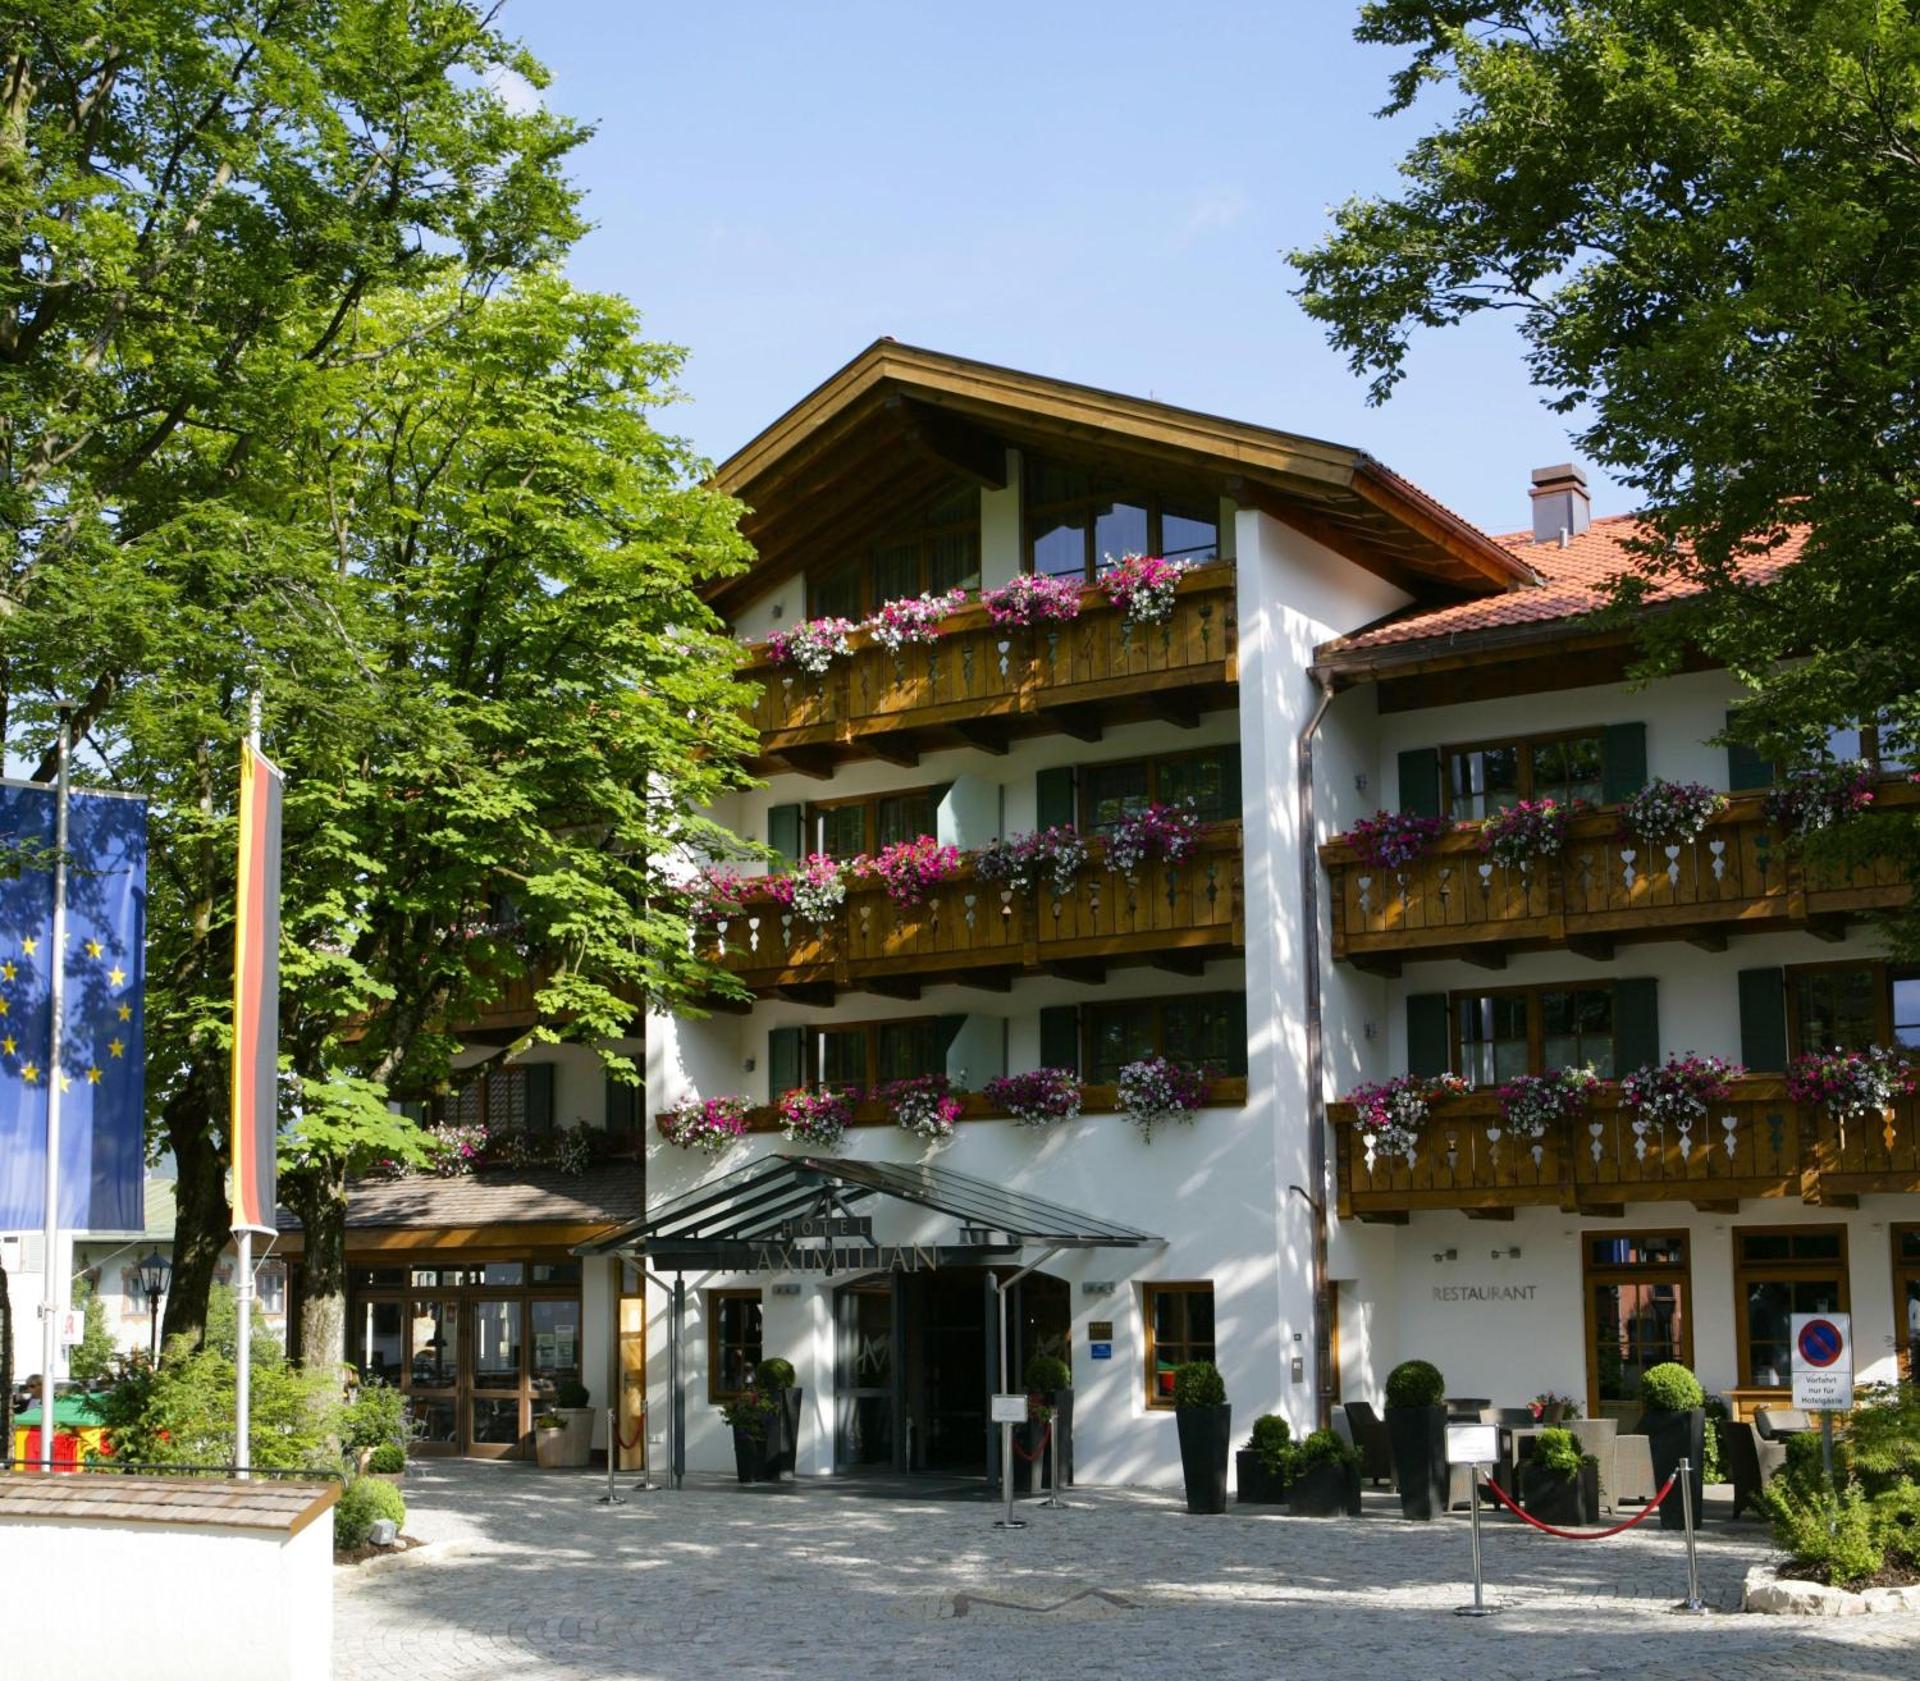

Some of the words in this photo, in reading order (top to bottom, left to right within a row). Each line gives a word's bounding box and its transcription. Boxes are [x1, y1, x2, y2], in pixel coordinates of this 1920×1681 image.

[782, 1219, 867, 1236] HOTEL
[720, 1241, 938, 1276] AXIMILIAN
[1432, 1286, 1537, 1301] RESTAURANT
[1806, 1376, 1837, 1384] Vorfahrt
